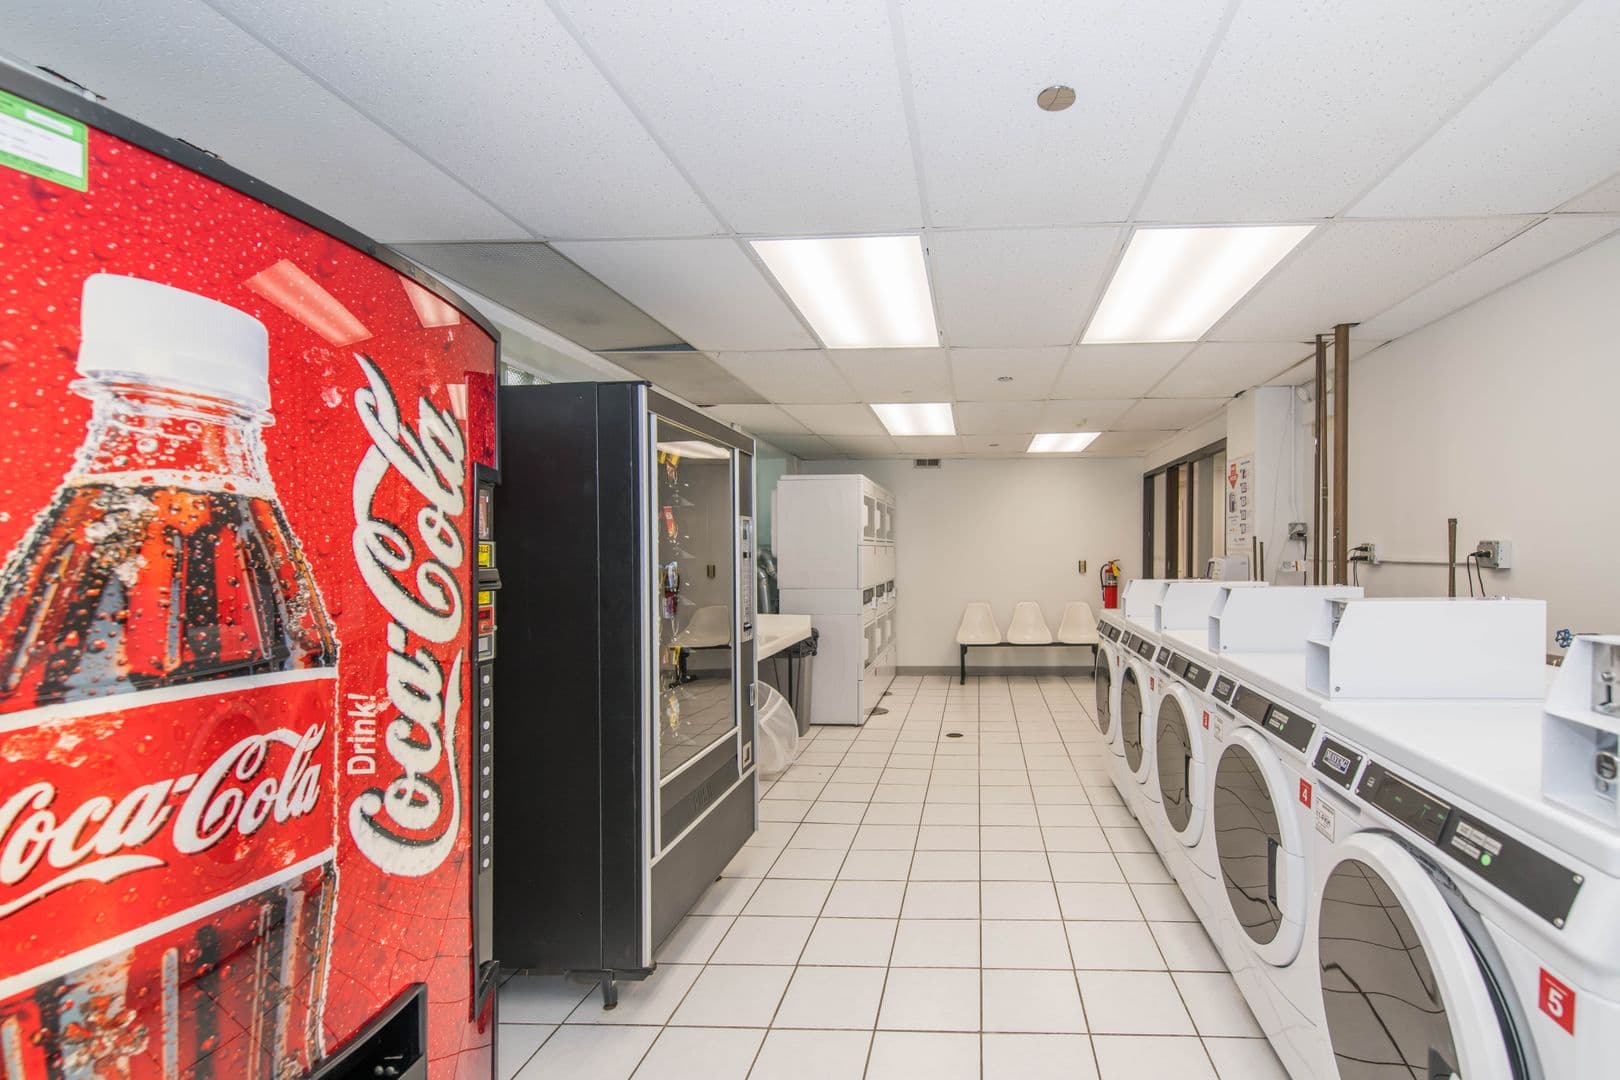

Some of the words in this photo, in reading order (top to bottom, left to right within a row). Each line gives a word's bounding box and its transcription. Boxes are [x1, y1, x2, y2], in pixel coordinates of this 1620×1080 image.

[349, 351, 466, 878] Coca-Cola
[347, 693, 376, 776] Drink!
[1326, 749, 1350, 768] MAYTAG
[1547, 986, 1564, 1018] 5
